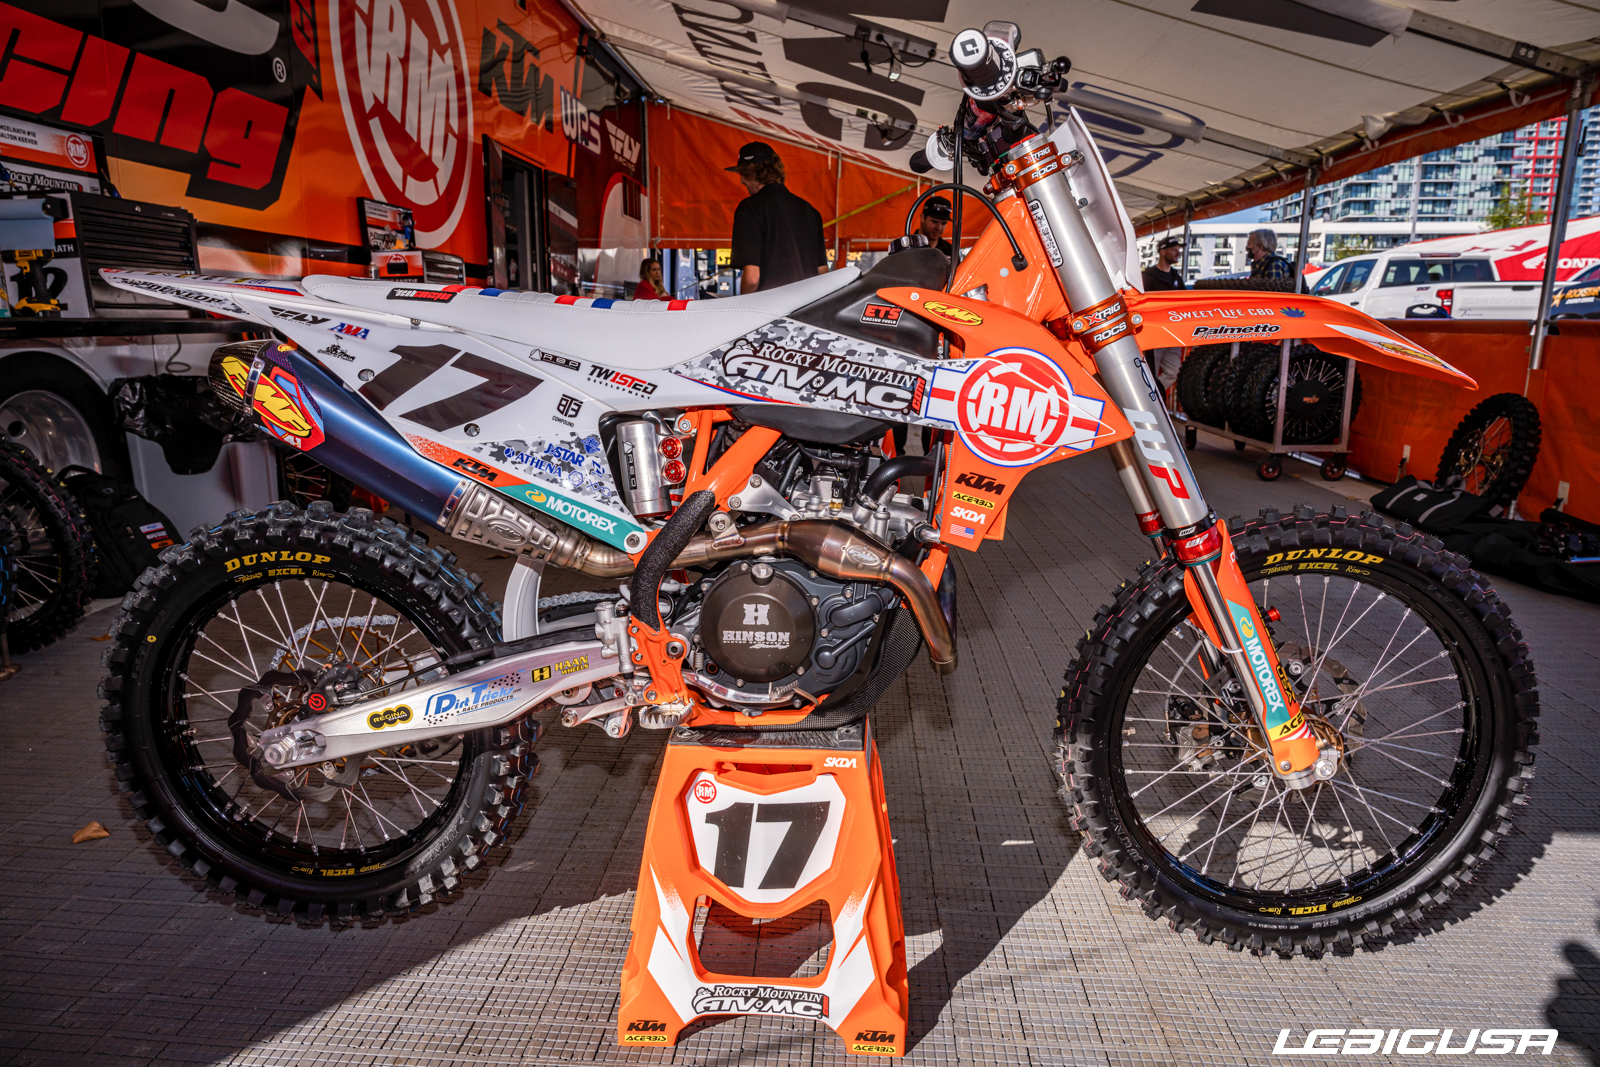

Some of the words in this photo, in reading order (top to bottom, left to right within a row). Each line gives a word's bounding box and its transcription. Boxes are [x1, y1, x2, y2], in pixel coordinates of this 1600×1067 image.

[478, 18, 554, 134] KTM
[19, 136, 38, 145] KEEVEN
[1031, 161, 1058, 180] ROCS
[33, 173, 79, 191] MOUNTAIN
[268, 306, 332, 325] FLY
[864, 303, 902, 320] ETS
[924, 301, 983, 325] FMF
[1084, 301, 1121, 325] XTRIG
[1168, 309, 1216, 322] SWEET
[1215, 308, 1246, 319] LIFE
[1247, 308, 1275, 316] CBD
[327, 322, 371, 341] AMA
[1093, 321, 1128, 344] ROCS
[1191, 323, 1281, 337] Palmetto
[759, 342, 817, 368] ROCKY
[816, 355, 916, 388] MOUNTAIN
[358, 343, 545, 433] 17
[552, 415, 575, 428] COMPOUND
[452, 458, 498, 483] KTM
[515, 452, 562, 477] ATHENA
[955, 472, 1006, 495] KTM
[953, 493, 994, 509] ACERBIS
[545, 496, 618, 535] MOTOREX
[950, 506, 986, 524] SKDA
[224, 551, 331, 573] DUNLOP
[1263, 548, 1384, 566] DUNLOP
[1297, 562, 1339, 570] EXCEL
[267, 568, 306, 577] EXCEL
[743, 603, 770, 626] H
[722, 630, 790, 642] HINSON
[554, 654, 589, 672] HAAN
[561, 663, 589, 676] WHEELS
[1245, 636, 1285, 714] MOTOREX
[434, 693, 470, 715] Dirt
[471, 683, 515, 706] Tricks
[462, 703, 479, 713] RACE
[480, 694, 514, 709] PRODUCTS
[372, 710, 406, 723] REGINA
[823, 757, 857, 768] SKDA
[704, 800, 831, 889] 17
[320, 867, 356, 877] EXCEL
[1288, 903, 1328, 916] EXCEL
[713, 986, 755, 997] ROCKY
[757, 986, 822, 1003] MOUNTAIN
[626, 1019, 667, 1032] KTM
[854, 1030, 896, 1043] KTM
[853, 1044, 896, 1053] ACERBIS
